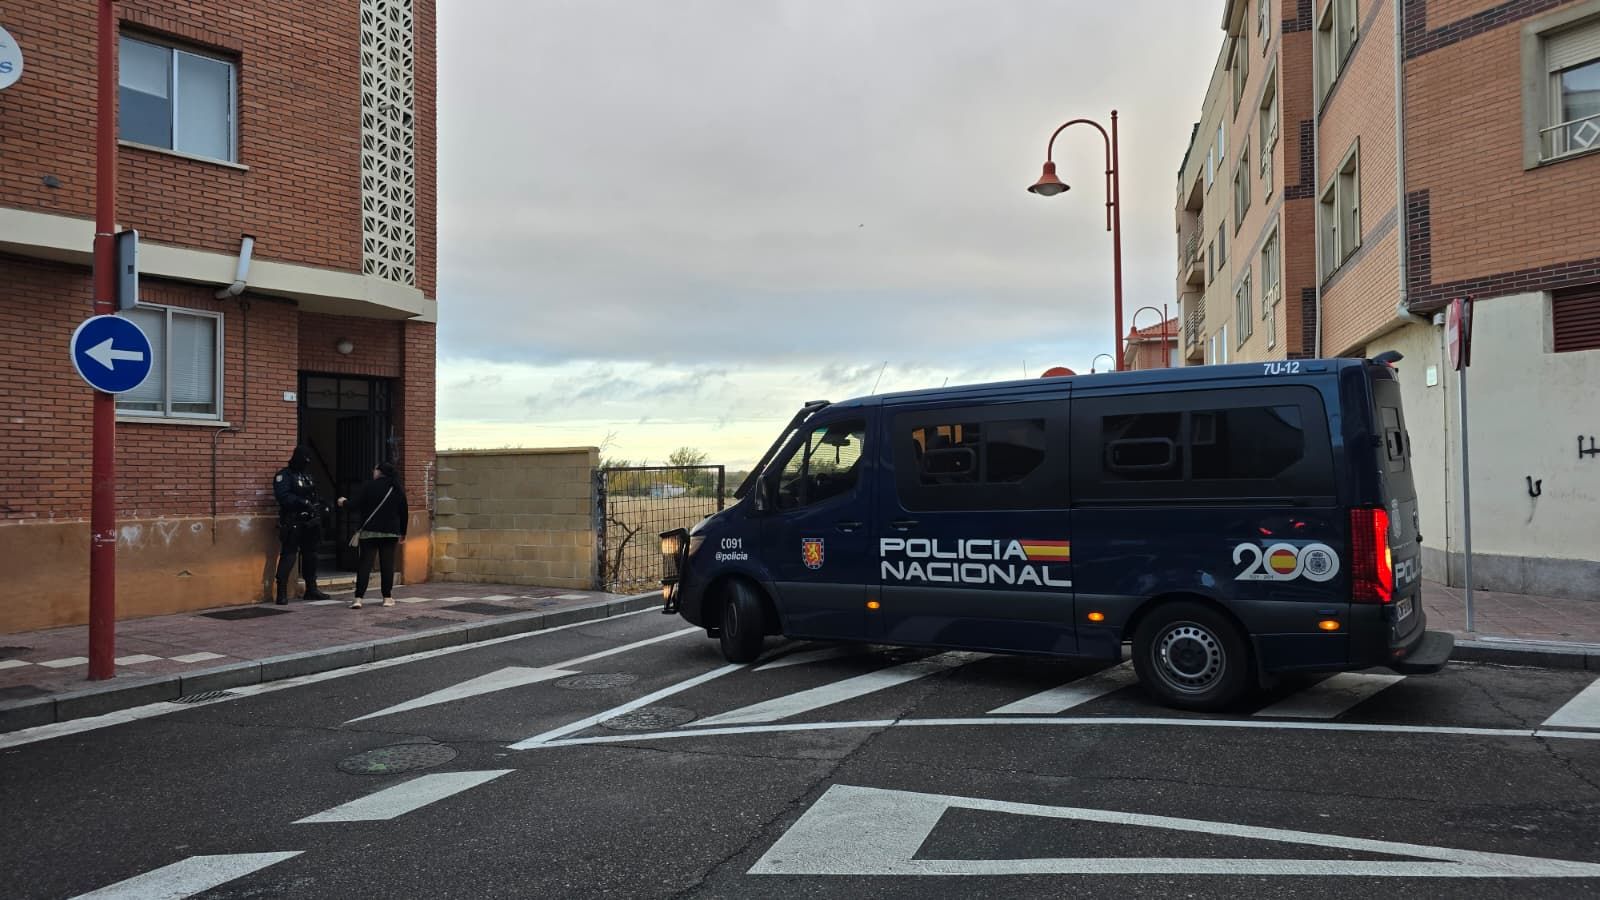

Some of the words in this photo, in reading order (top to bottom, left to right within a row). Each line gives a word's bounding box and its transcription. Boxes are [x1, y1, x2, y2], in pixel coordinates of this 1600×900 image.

[1263, 361, 1300, 375] 7U-12
[715, 551, 748, 563] @policia
[880, 560, 1072, 587] NACIONAL
